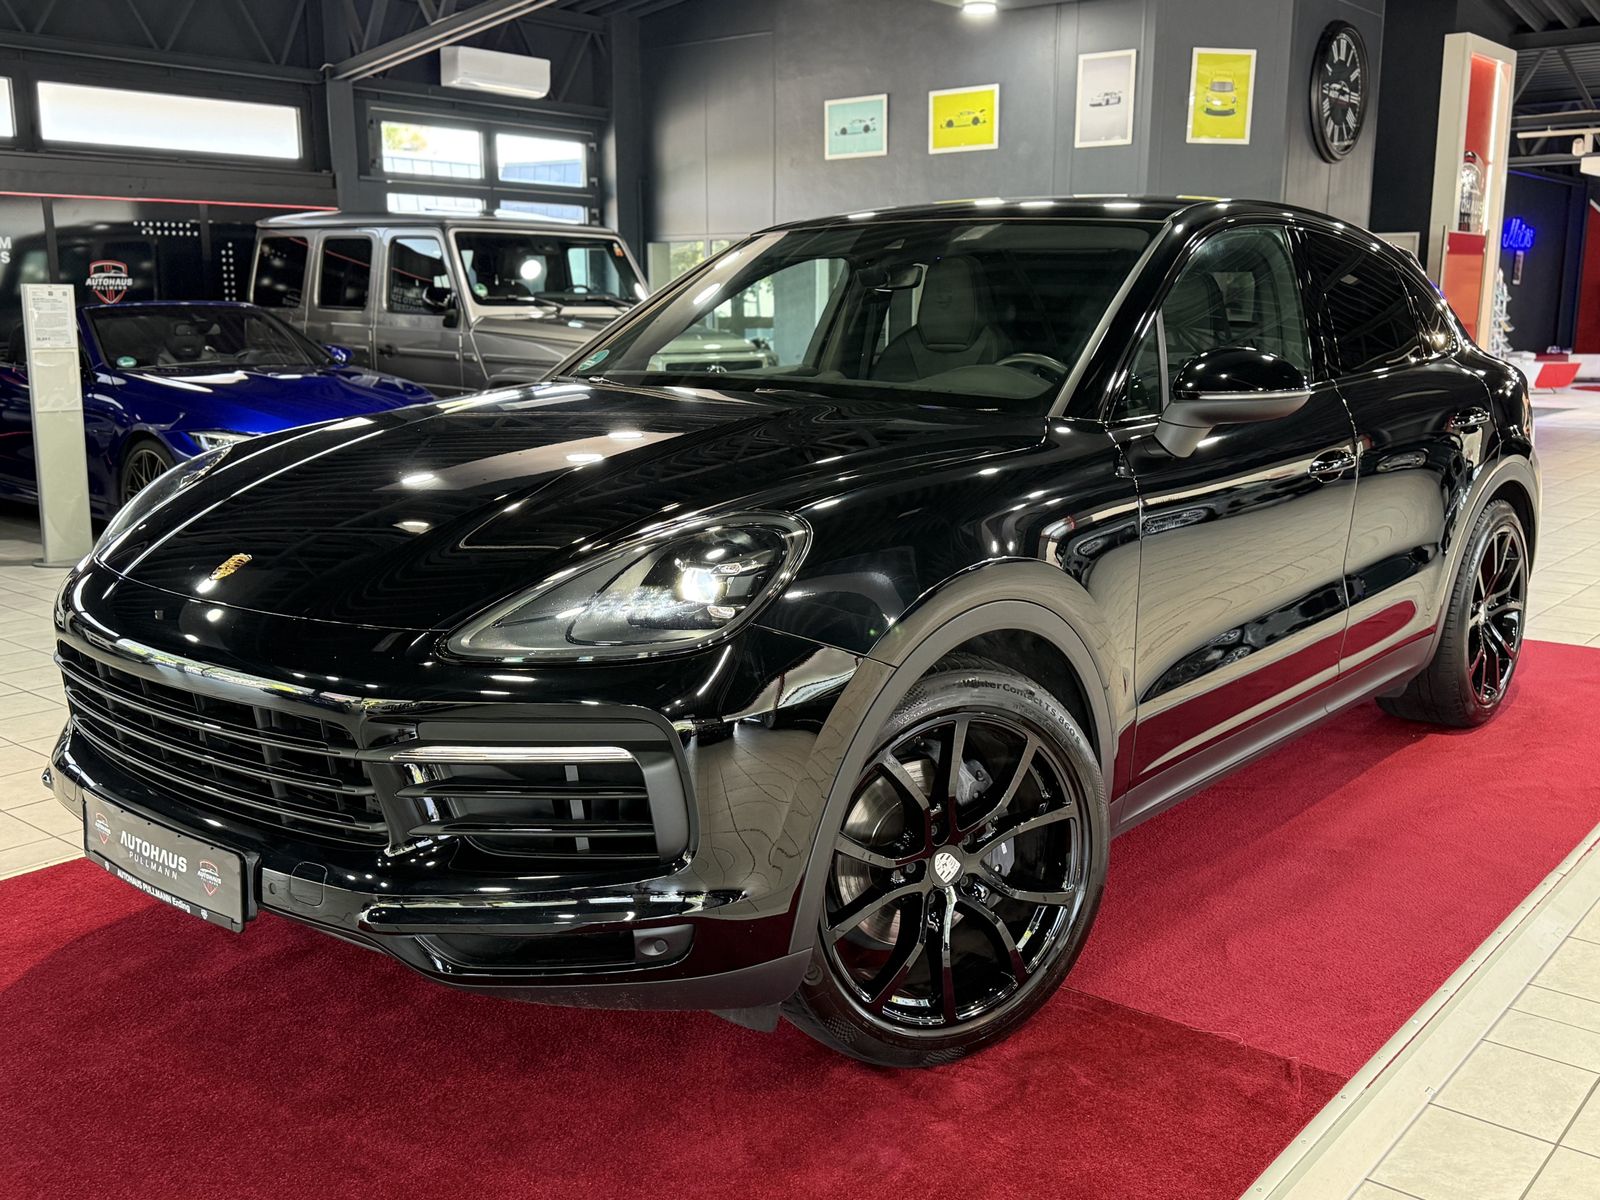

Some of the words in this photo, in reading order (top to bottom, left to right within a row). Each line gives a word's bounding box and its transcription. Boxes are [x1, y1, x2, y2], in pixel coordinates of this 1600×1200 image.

[85, 278, 133, 286] AUTOHAUS
[120, 830, 188, 873] AUTOHAUS
[129, 850, 178, 880] PULLMANN
[117, 868, 143, 889] AUTOHAUS
[142, 882, 172, 904] PULLMANN
